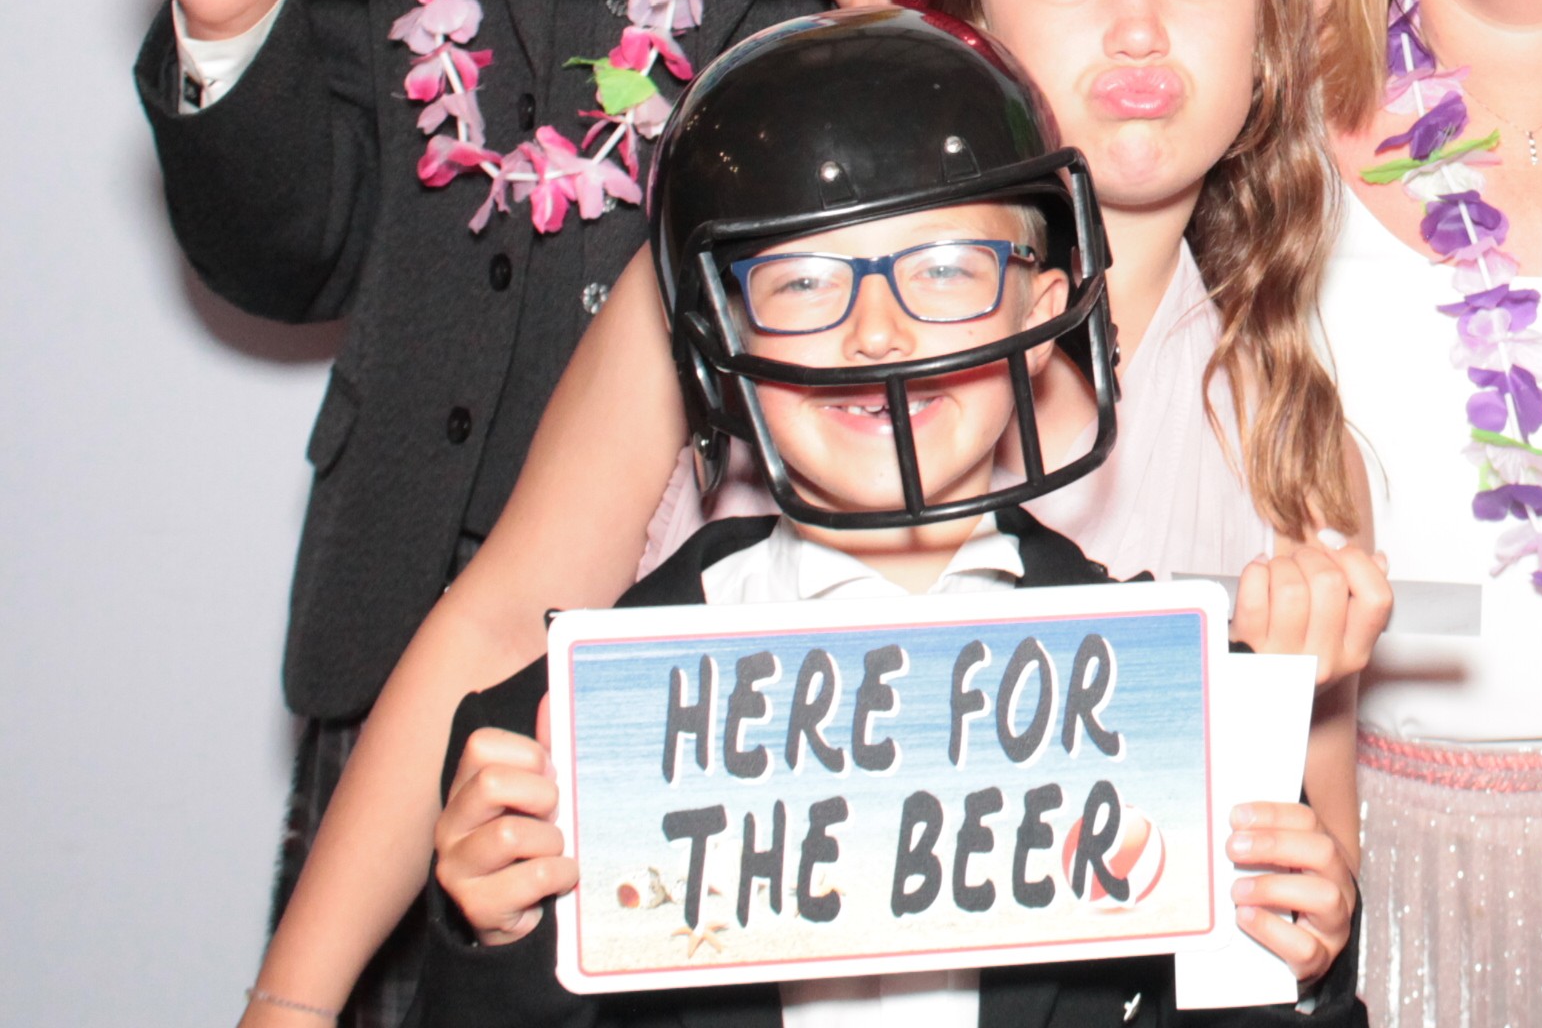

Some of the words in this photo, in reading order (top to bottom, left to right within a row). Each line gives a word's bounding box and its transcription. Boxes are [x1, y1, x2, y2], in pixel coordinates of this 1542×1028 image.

[662, 644, 905, 783] HERE
[948, 633, 1121, 767] FOR
[662, 796, 849, 929] THE
[890, 780, 1131, 917] BEER
